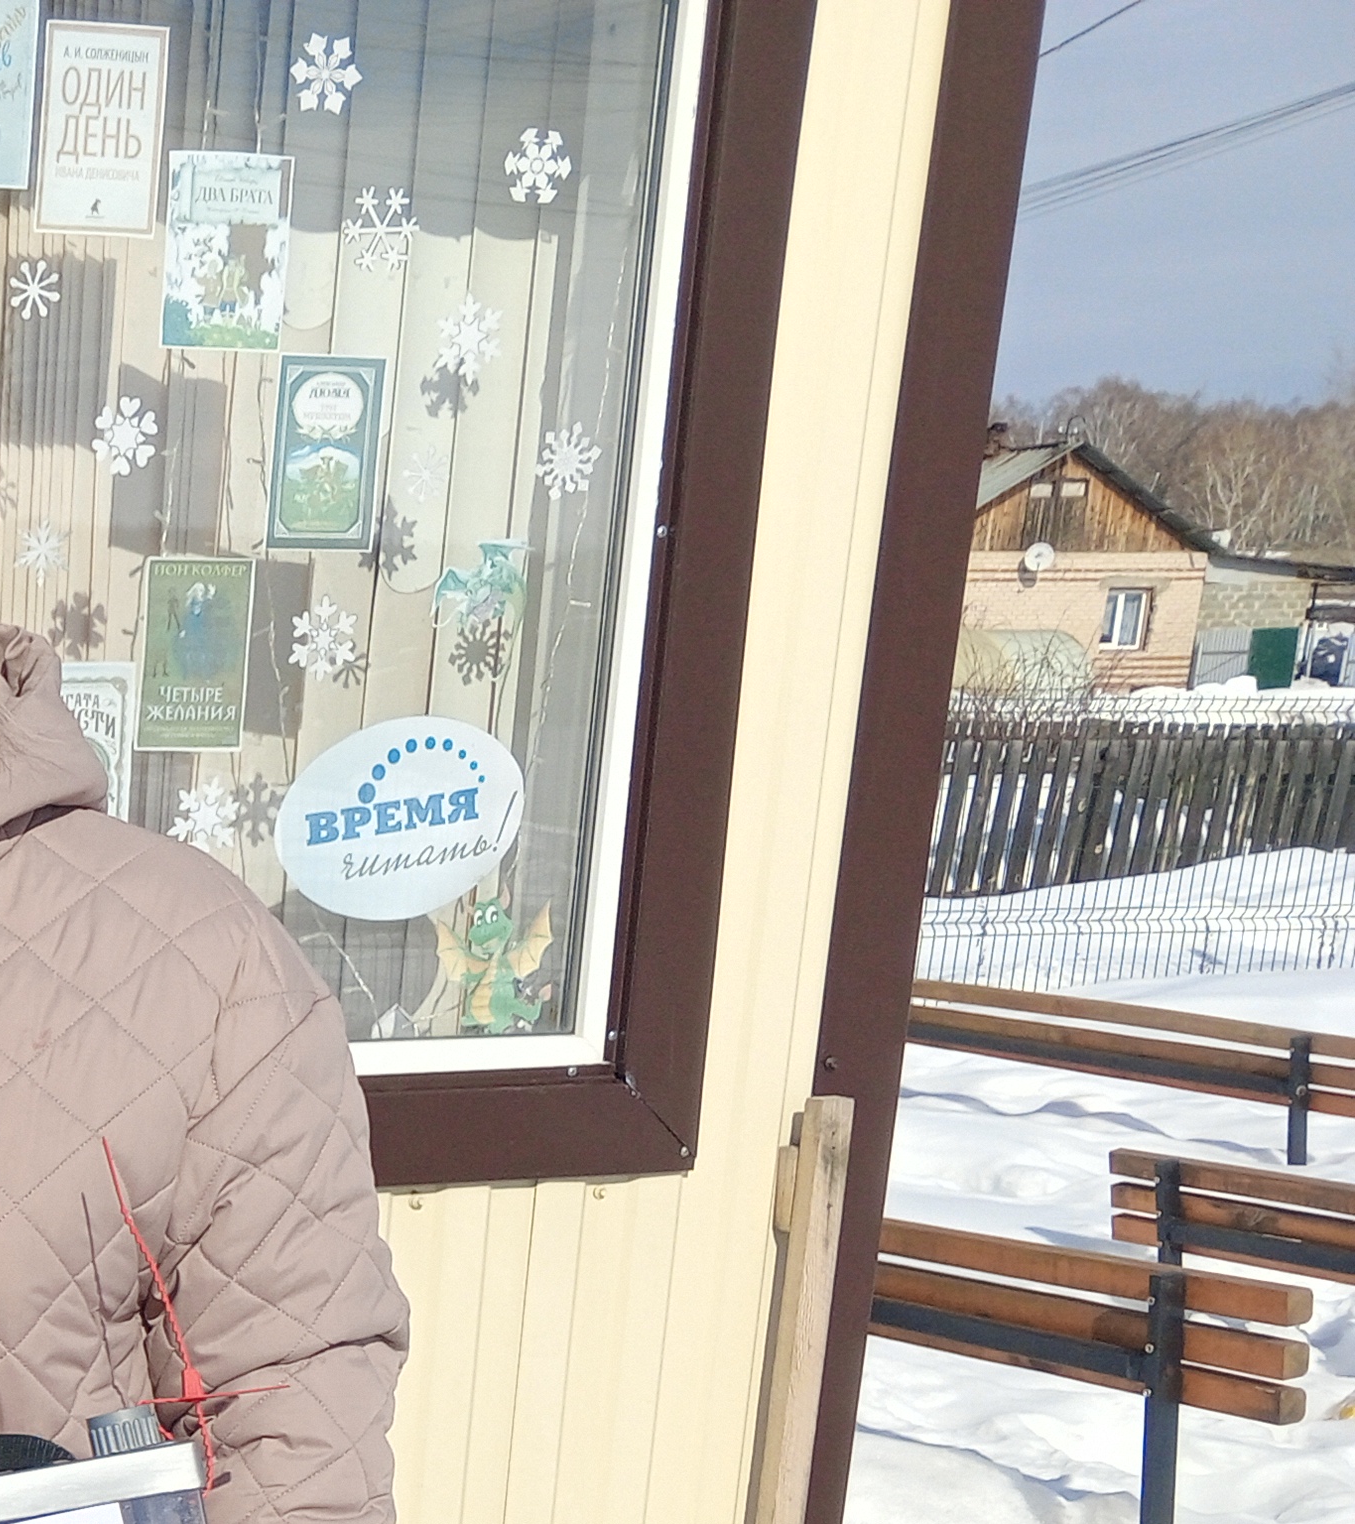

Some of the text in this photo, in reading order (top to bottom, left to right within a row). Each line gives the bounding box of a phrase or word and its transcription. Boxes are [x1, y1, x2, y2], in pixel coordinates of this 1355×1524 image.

[85, 47, 149, 64] СОЛЖЕНИЦЫН
[62, 66, 147, 115] ОДИН
[56, 113, 142, 165] ДЕНЬ
[195, 186, 273, 205] ДВА БРАТА
[191, 564, 247, 577] КОЛФЕР
[65, 693, 100, 709] ГАТА
[159, 686, 223, 704] ЧЕТЫРЕ
[146, 705, 236, 722] ЖЕЛАНИЯ
[305, 787, 479, 846] ВРЕМЯ
